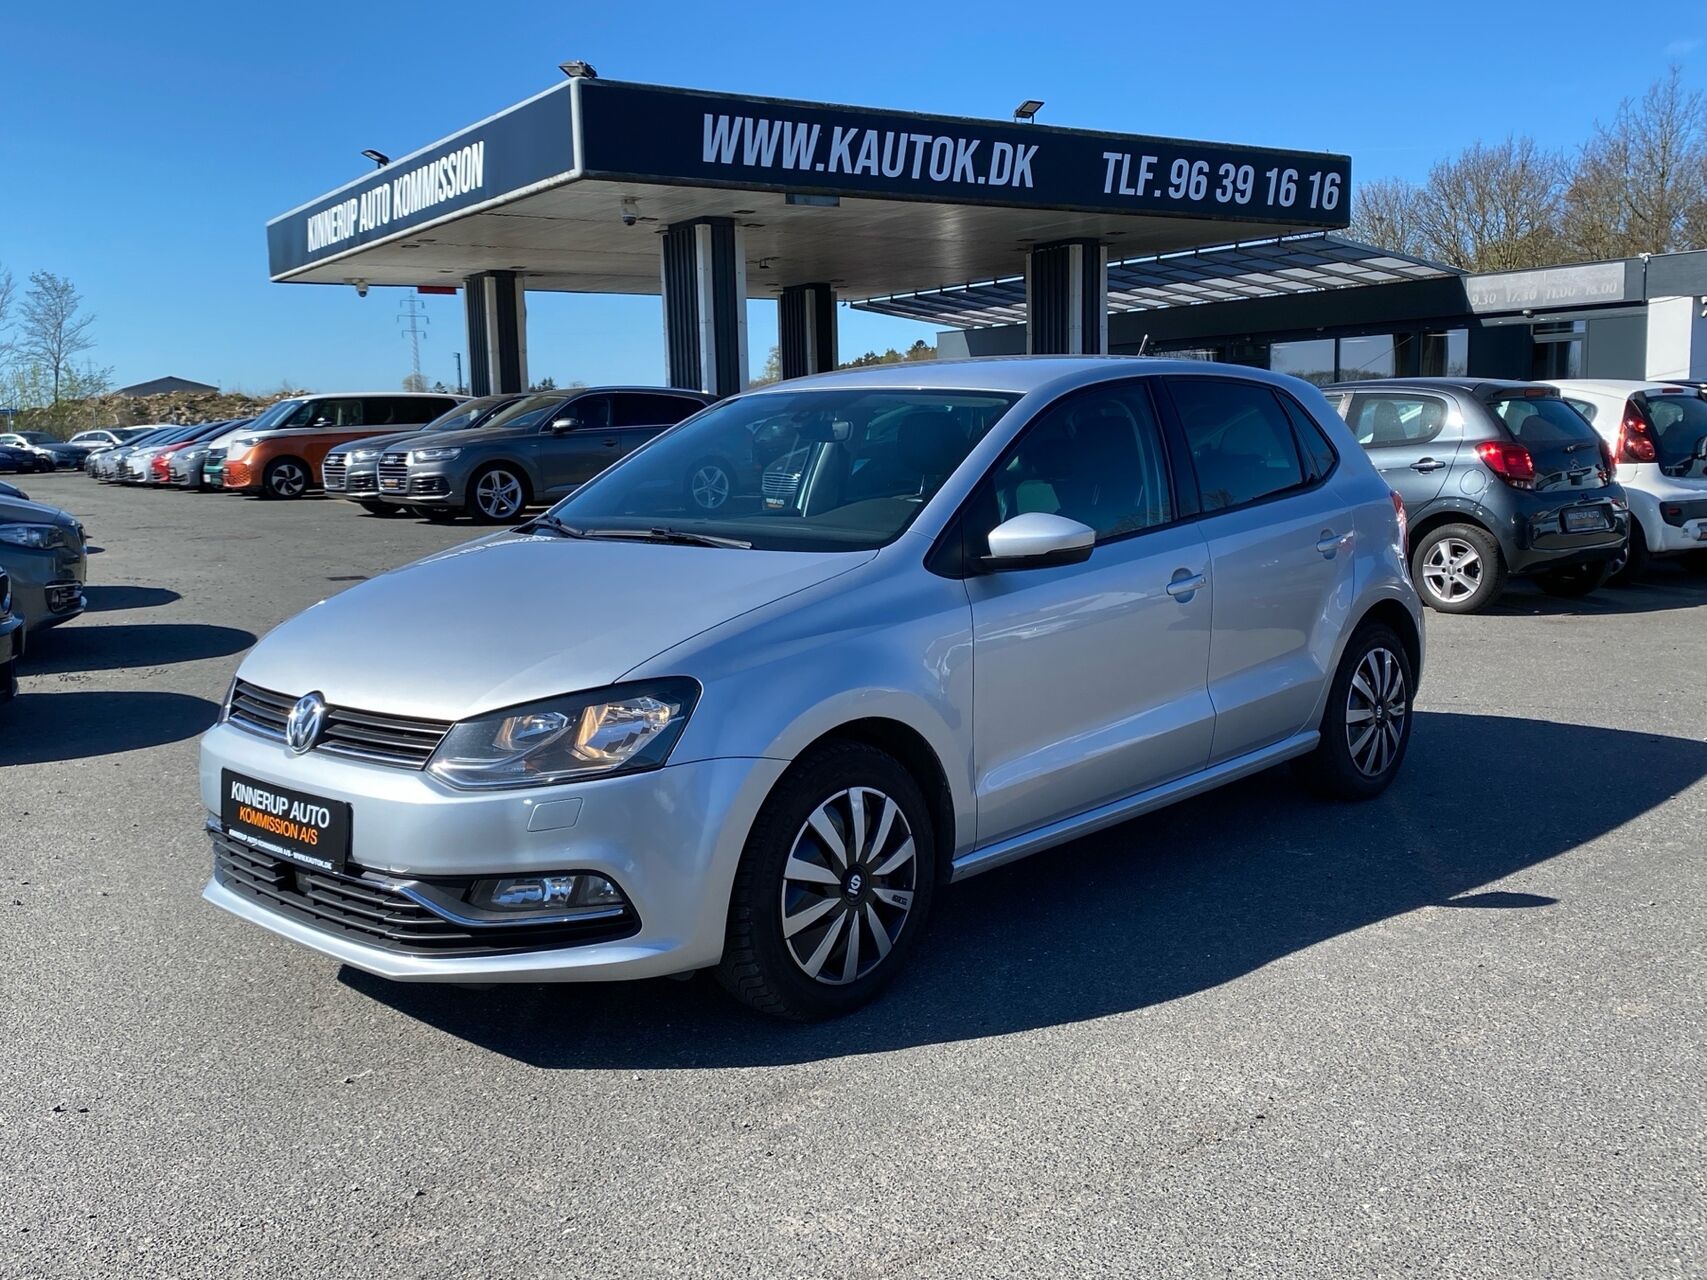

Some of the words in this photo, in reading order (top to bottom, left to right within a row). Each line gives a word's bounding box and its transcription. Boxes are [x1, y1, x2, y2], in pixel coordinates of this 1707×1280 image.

[703, 113, 1039, 188] WWW.KAUTOK.DK
[307, 198, 358, 252] KINNERUP
[359, 183, 391, 232] AUTO
[393, 141, 484, 220] KOMMISSION
[1103, 152, 1161, 197] TLF.
[1168, 158, 1209, 201] 96
[1216, 163, 1255, 204] 39
[1265, 167, 1298, 207] 16
[1309, 171, 1341, 210] 16
[231, 781, 288, 816] KINNERUP
[289, 801, 330, 829] AUTO
[239, 806, 298, 839] KOMMISSION
[299, 827, 318, 845] A/S
